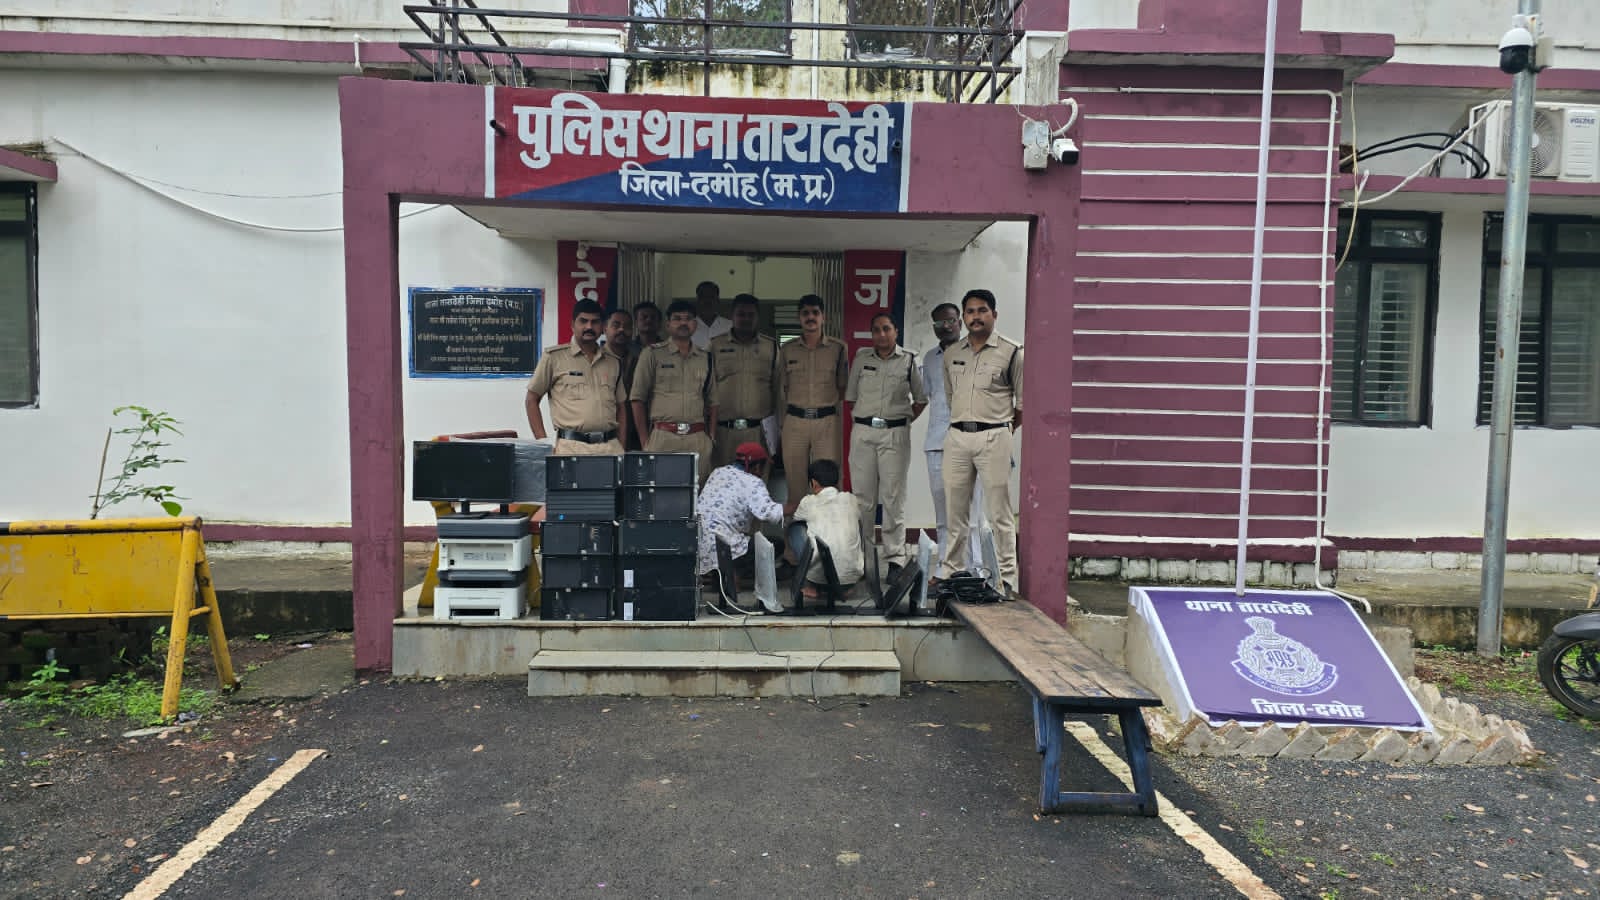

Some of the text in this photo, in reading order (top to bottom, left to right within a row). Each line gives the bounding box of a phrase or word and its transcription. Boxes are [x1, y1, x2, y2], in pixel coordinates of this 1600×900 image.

[513, 93, 895, 173] पुलिस थाना तारादेही
[619, 161, 763, 205] जिला-दमोह
[1184, 600, 1313, 616] थाना तारादेही
[1251, 697, 1366, 718] जिला-दमोह
